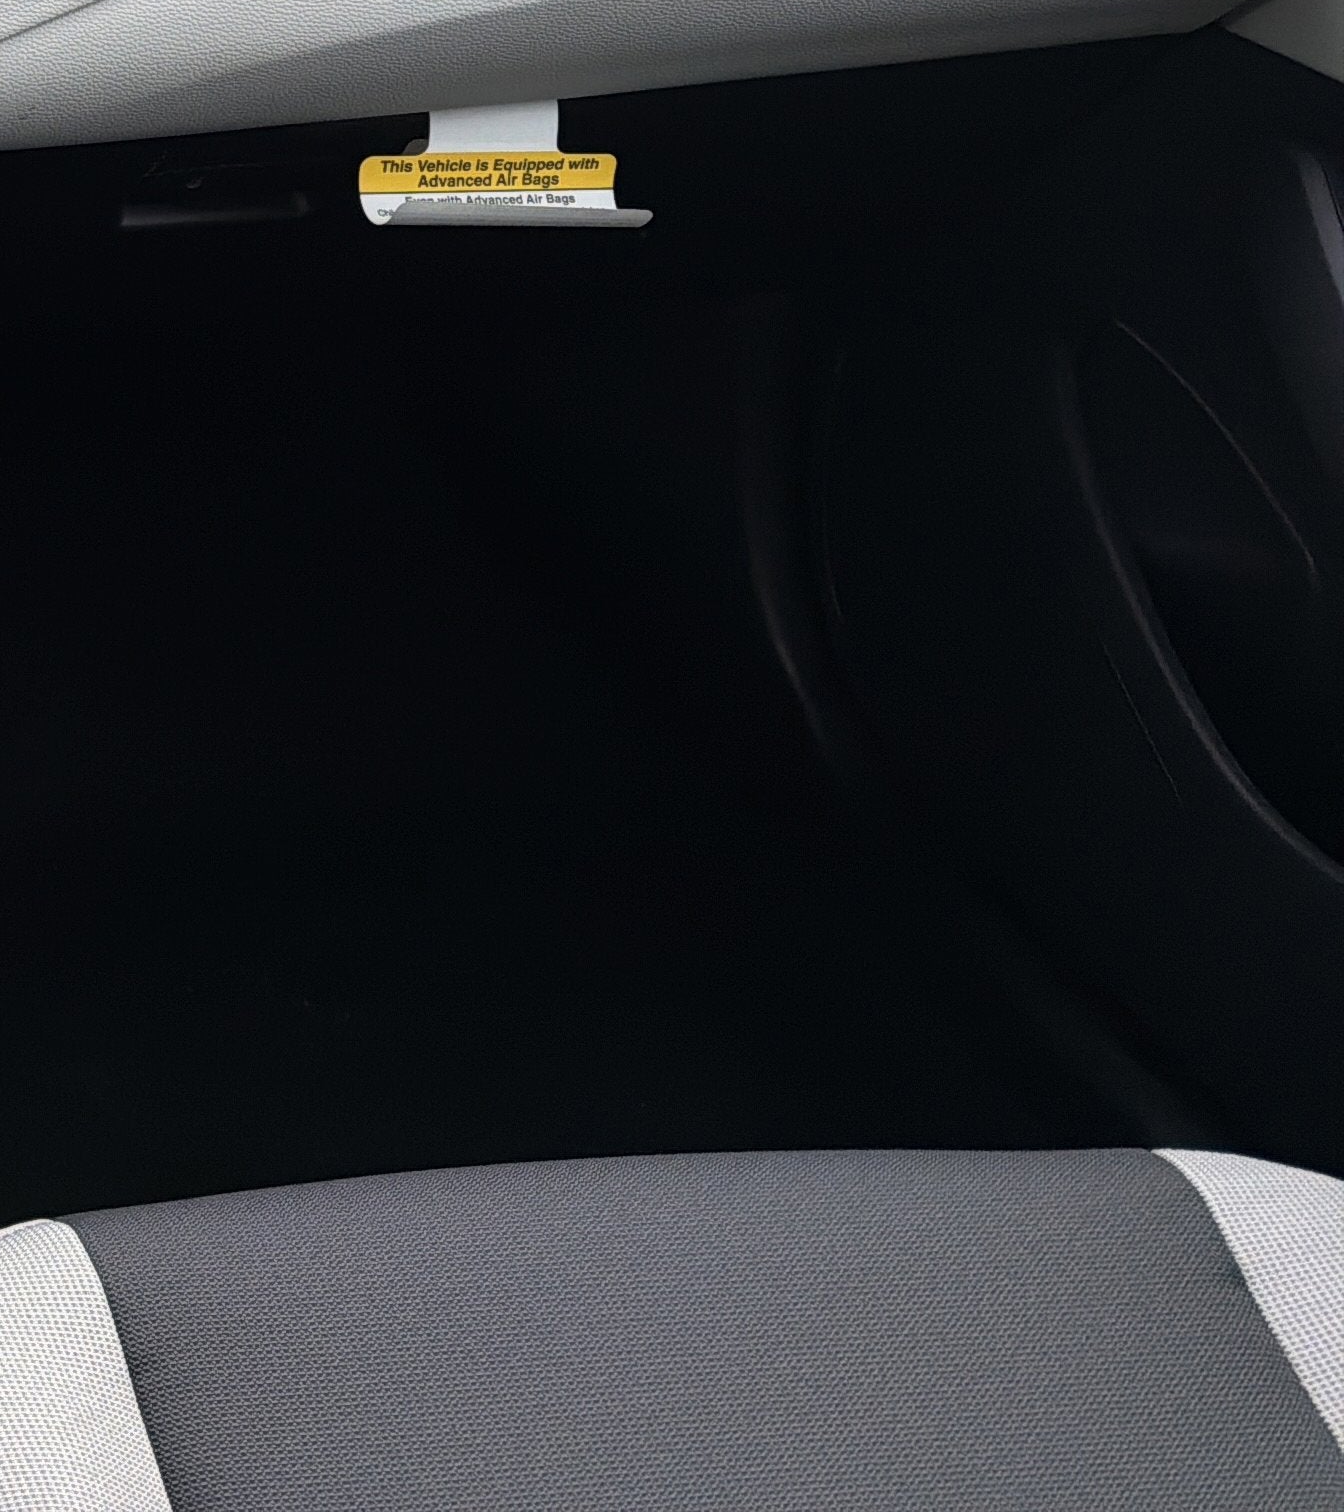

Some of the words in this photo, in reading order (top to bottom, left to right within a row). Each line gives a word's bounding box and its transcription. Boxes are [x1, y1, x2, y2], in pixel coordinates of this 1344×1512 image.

[380, 159, 414, 174] This
[417, 159, 472, 173] Vehicle
[493, 157, 565, 175] Equipped
[568, 156, 600, 170] with
[417, 173, 493, 188] Advanced
[496, 172, 518, 187] Air
[521, 172, 560, 189] Bags
[466, 194, 523, 205] Advanced
[526, 193, 543, 205] Air
[546, 193, 576, 206] Bags
